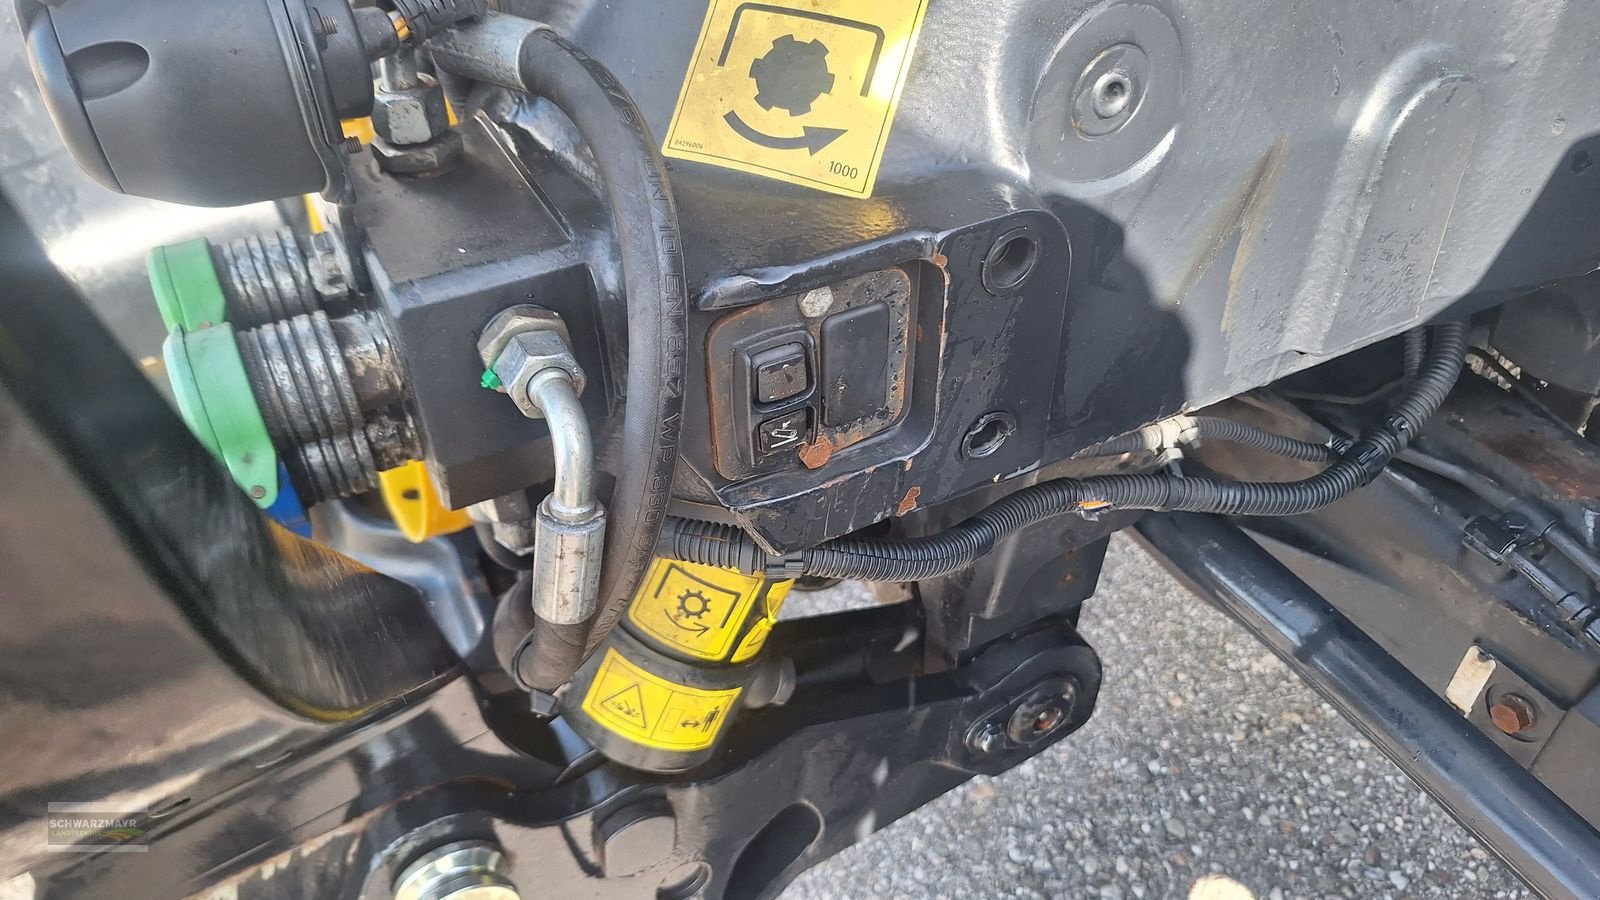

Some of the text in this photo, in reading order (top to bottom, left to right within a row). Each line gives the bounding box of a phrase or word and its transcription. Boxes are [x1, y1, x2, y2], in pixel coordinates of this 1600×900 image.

[829, 160, 859, 180] 1000
[664, 273, 684, 320] EN
[665, 334, 684, 398] 857
[660, 412, 681, 463] WP
